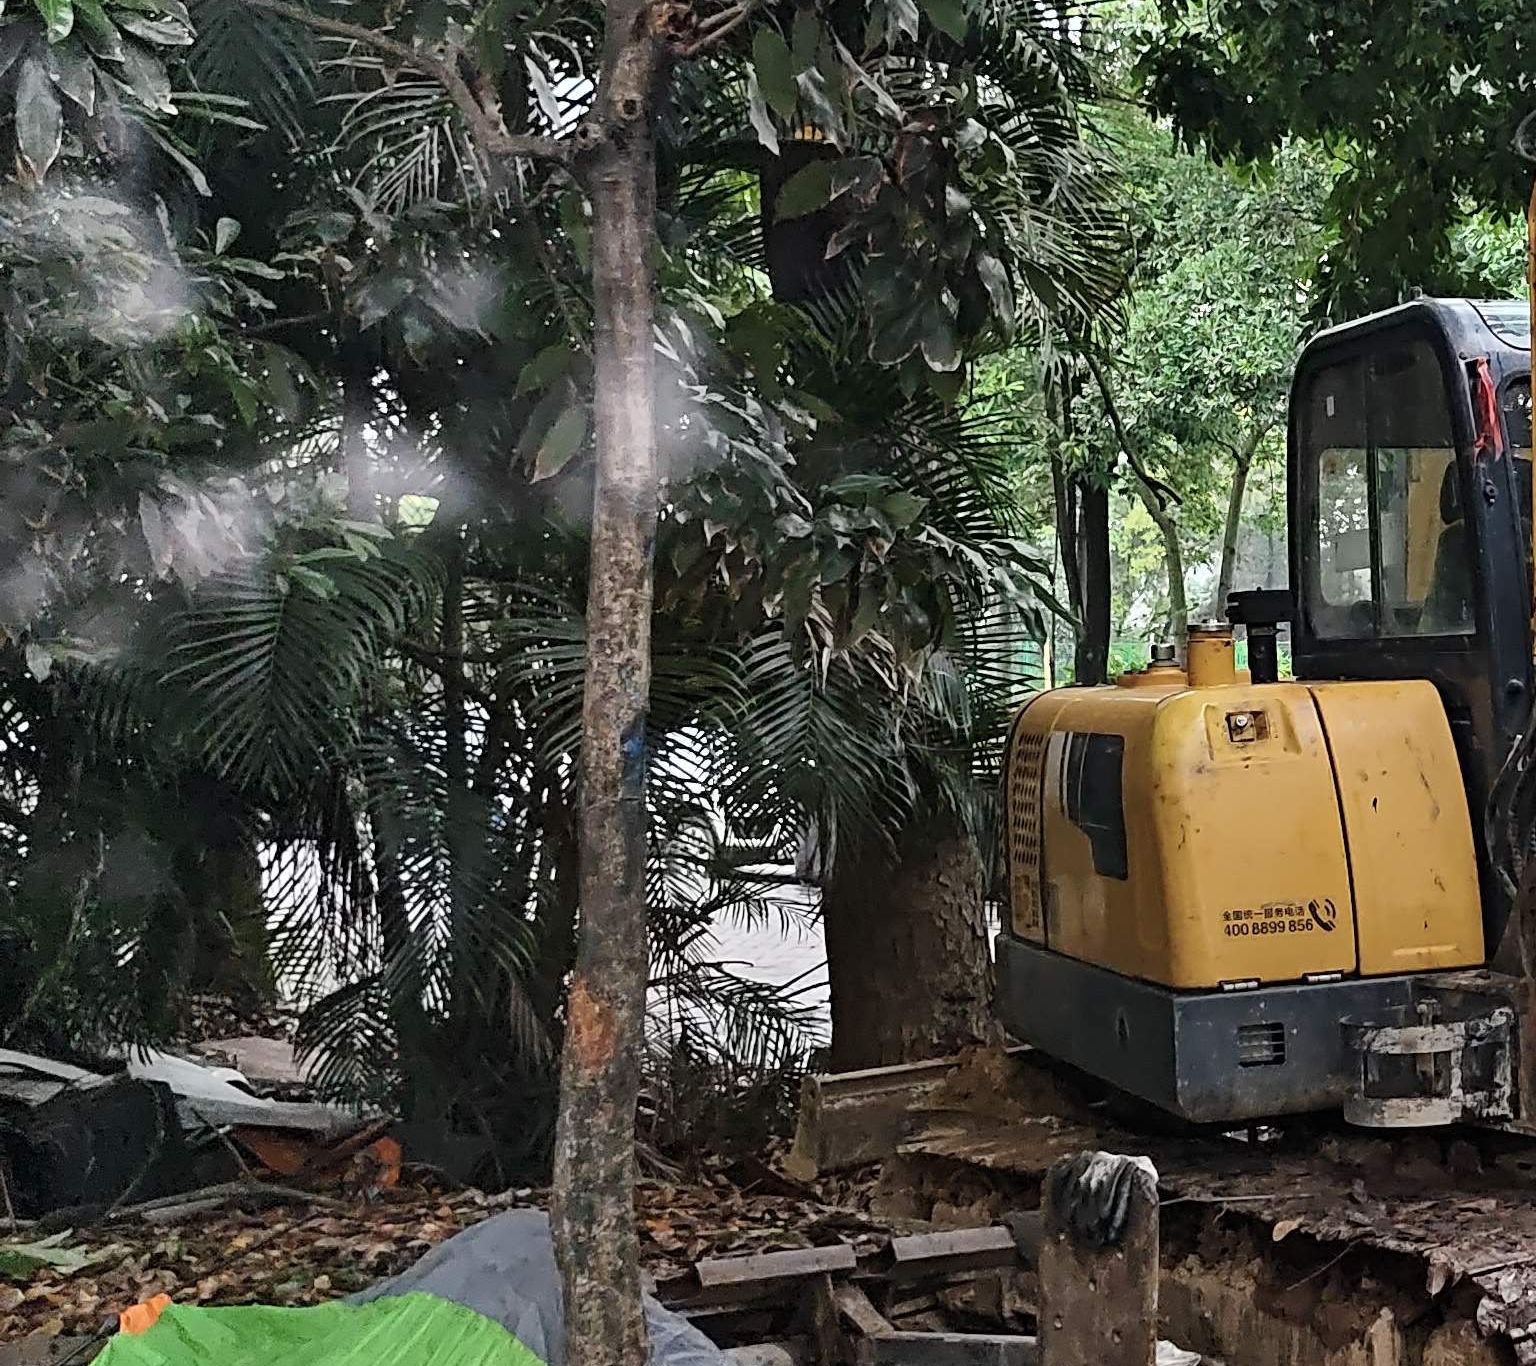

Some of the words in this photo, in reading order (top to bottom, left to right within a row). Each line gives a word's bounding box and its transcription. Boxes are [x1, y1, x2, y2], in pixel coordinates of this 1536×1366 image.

[1224, 923, 1249, 937] 400
[1251, 920, 1286, 935] 8899
[1288, 918, 1313, 933] 856
